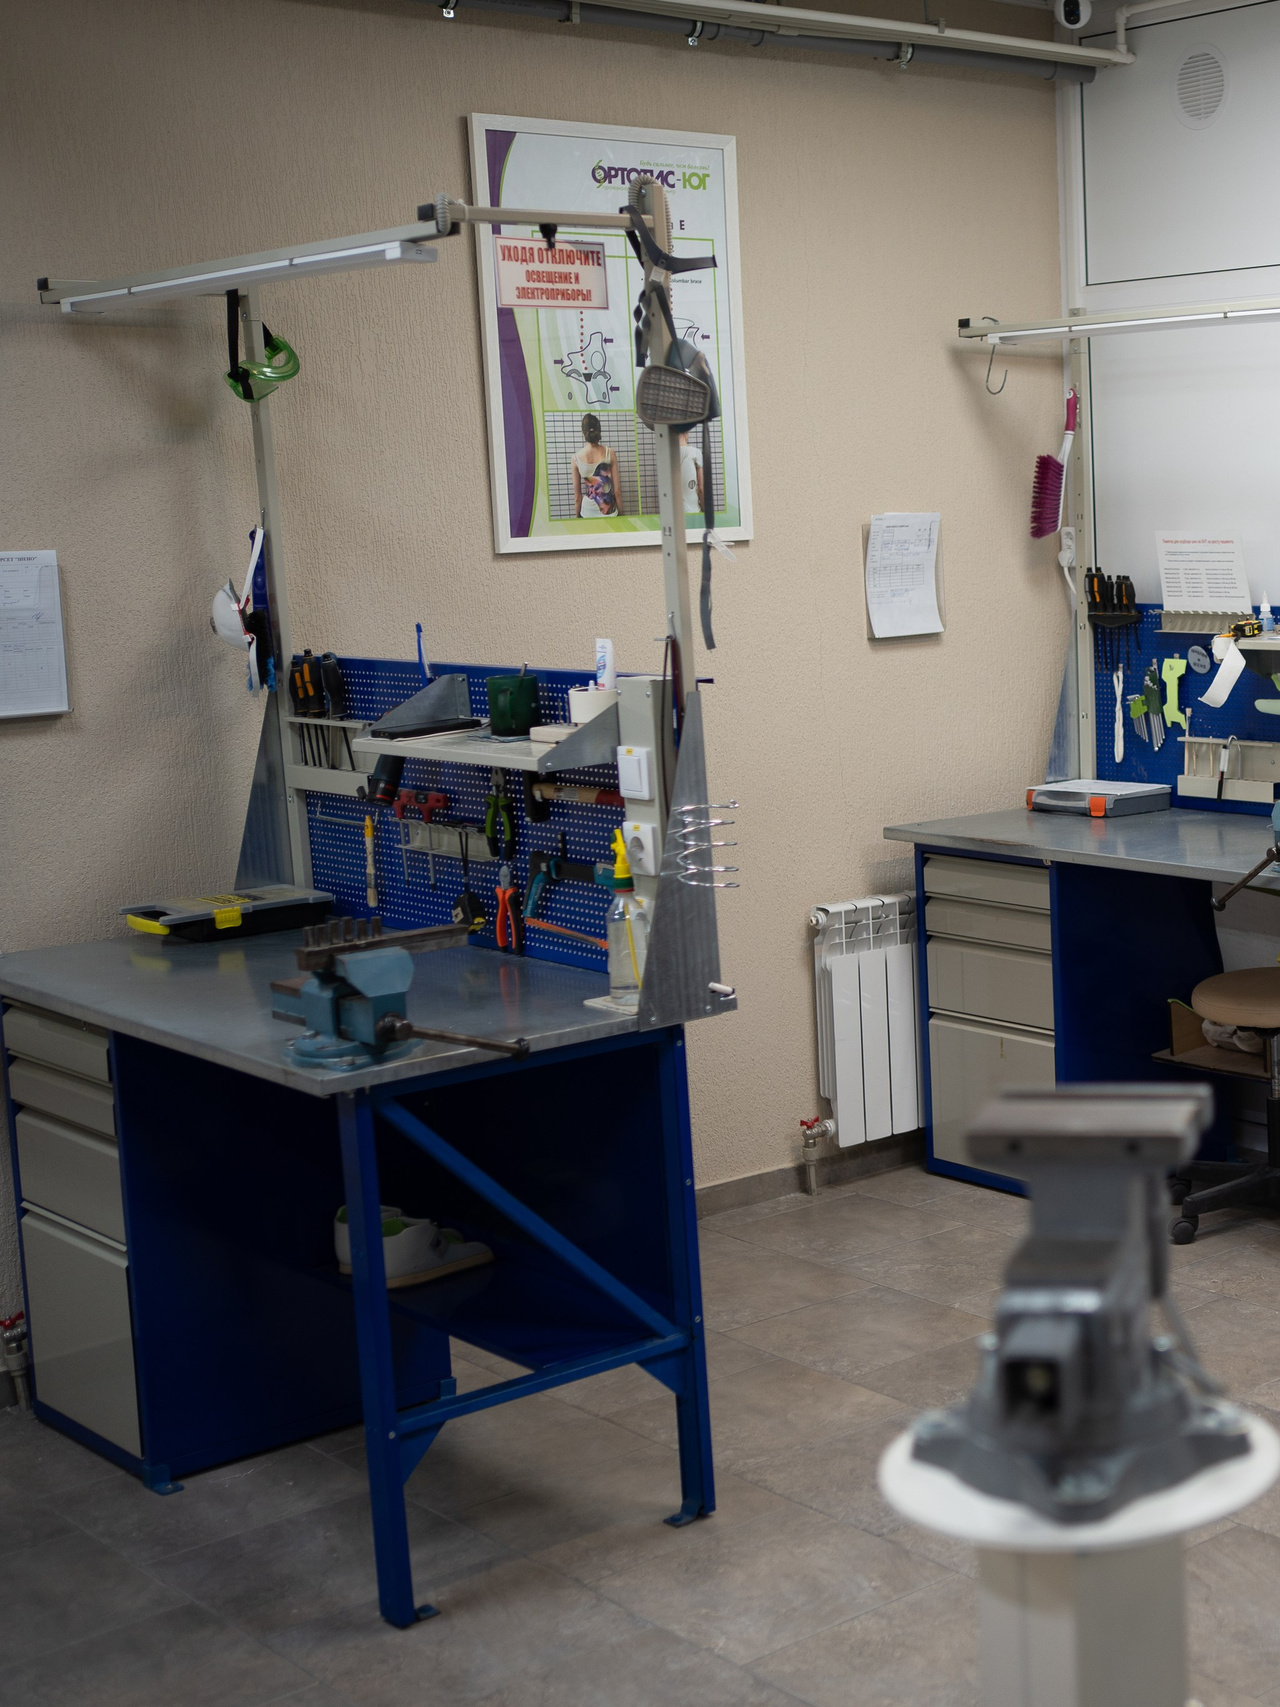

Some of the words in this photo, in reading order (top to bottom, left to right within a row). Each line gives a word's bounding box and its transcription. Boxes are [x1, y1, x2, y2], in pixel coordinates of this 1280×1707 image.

[500, 245, 535, 265] УХОДЯ
[537, 247, 602, 266] ОТКЛЮЧИТЕ
[525, 269, 573, 285] ОСВЕЩЕНИЕ
[574, 272, 580, 284] И
[515, 286, 592, 302] ЭЛЕКТРОПРИБОРЫ!
